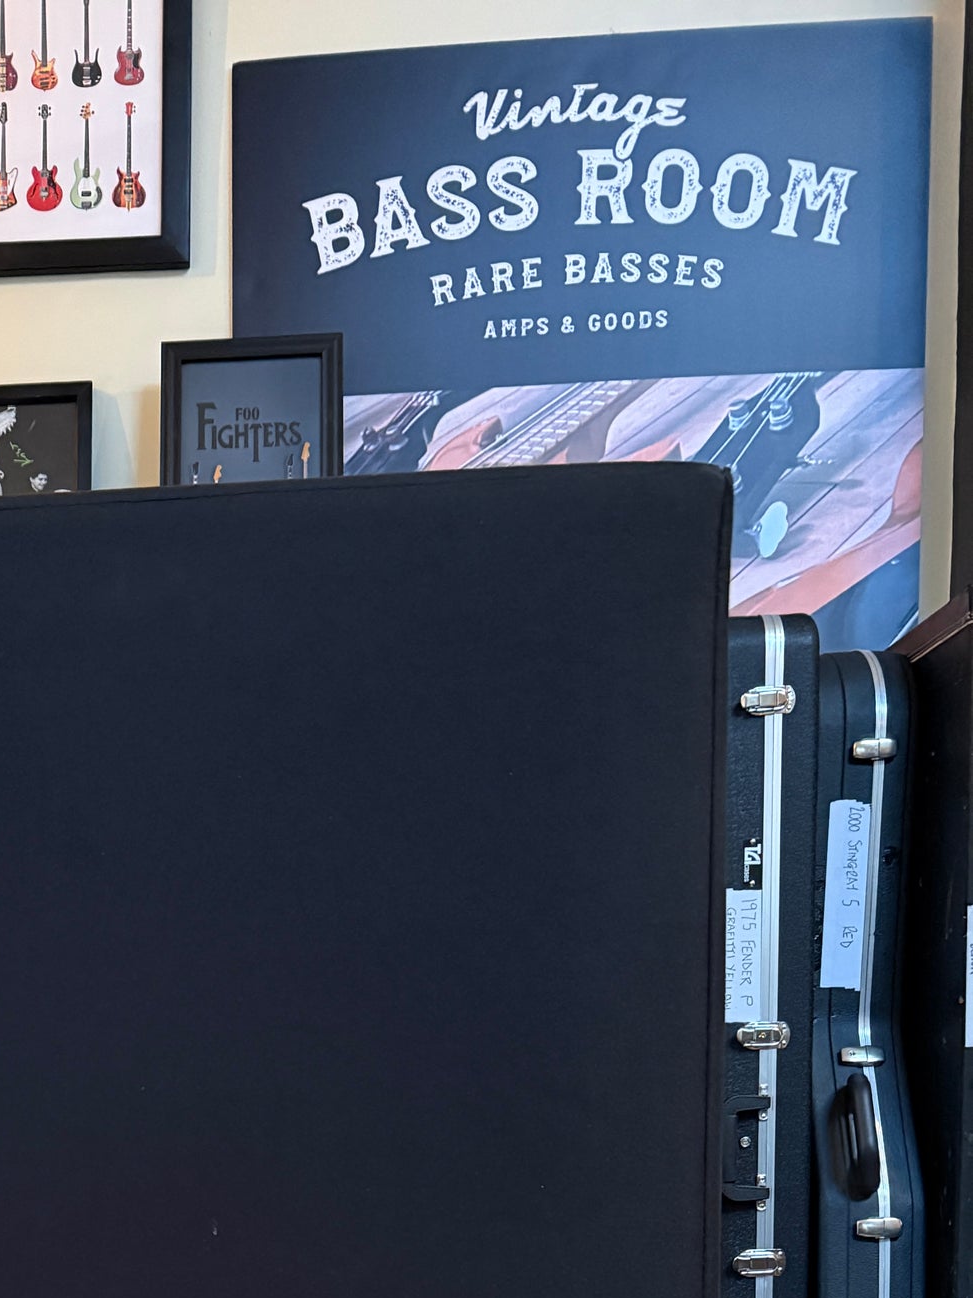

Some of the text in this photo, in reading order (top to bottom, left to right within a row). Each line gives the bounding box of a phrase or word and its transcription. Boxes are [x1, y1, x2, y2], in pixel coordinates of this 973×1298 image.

[463, 83, 687, 159] Vintage
[302, 148, 858, 275] BASS ROOM
[430, 252, 724, 306] RARE BASSES
[484, 310, 669, 339] AMPS & GOODS
[235, 406, 260, 421] FOO
[840, 806, 865, 948] 2000 STINGRAY 5 RED
[739, 898, 758, 1007] 1975 FENDER P
